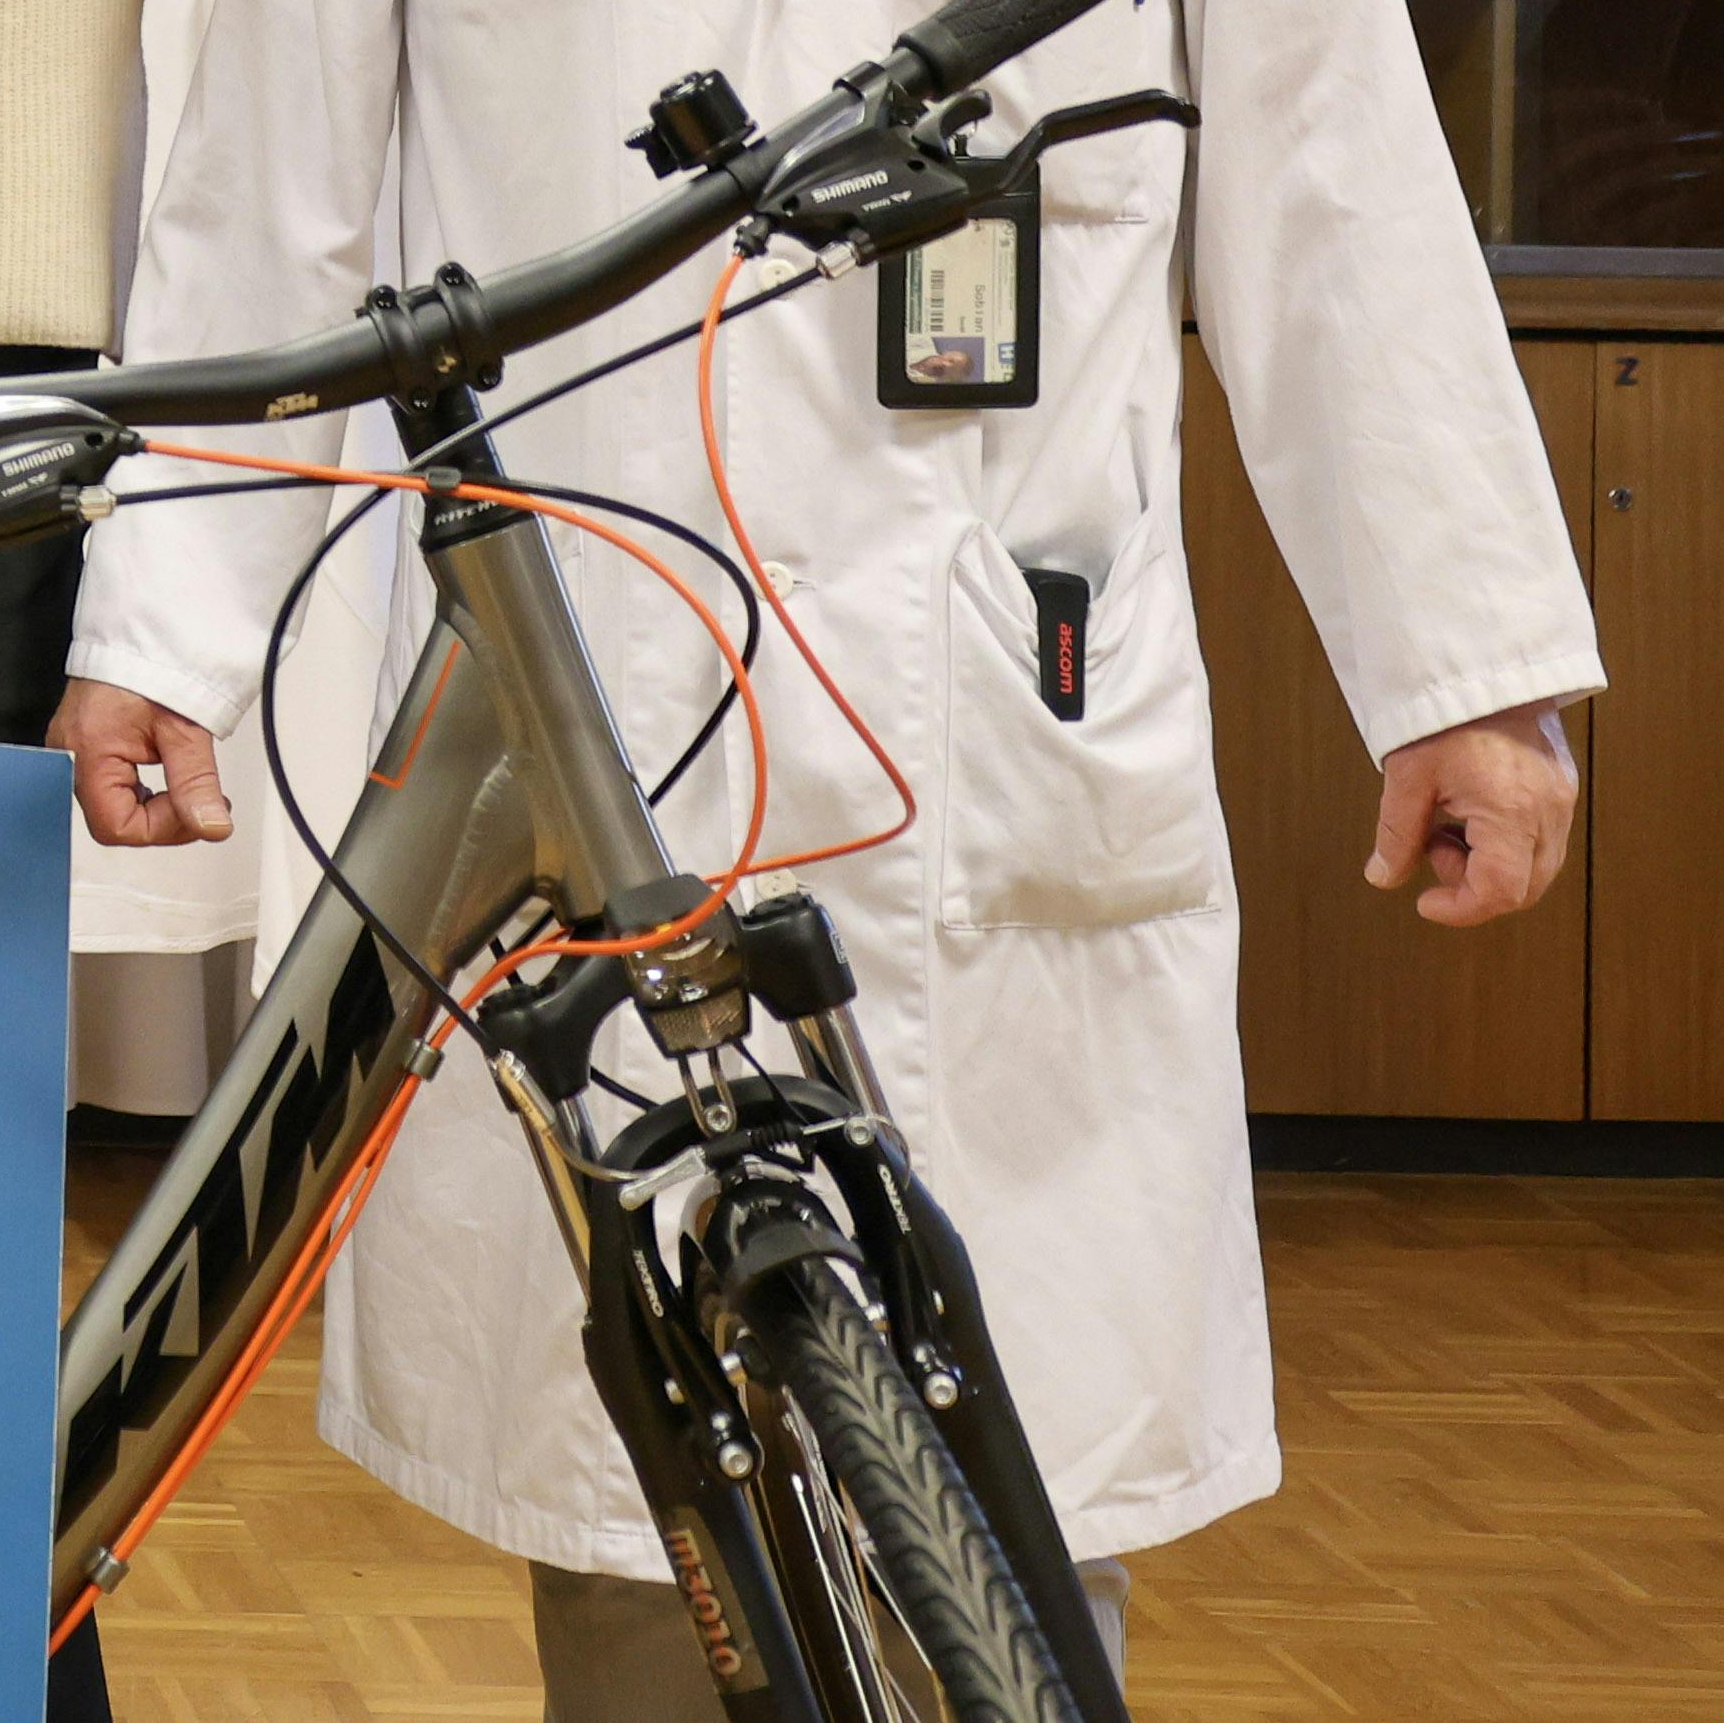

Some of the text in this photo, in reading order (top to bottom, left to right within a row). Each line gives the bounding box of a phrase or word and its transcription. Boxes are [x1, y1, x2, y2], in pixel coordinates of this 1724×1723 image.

[811, 170, 889, 204] SHIMANO
[1, 442, 76, 477] SHIMANO
[1058, 622, 1073, 694] ascom
